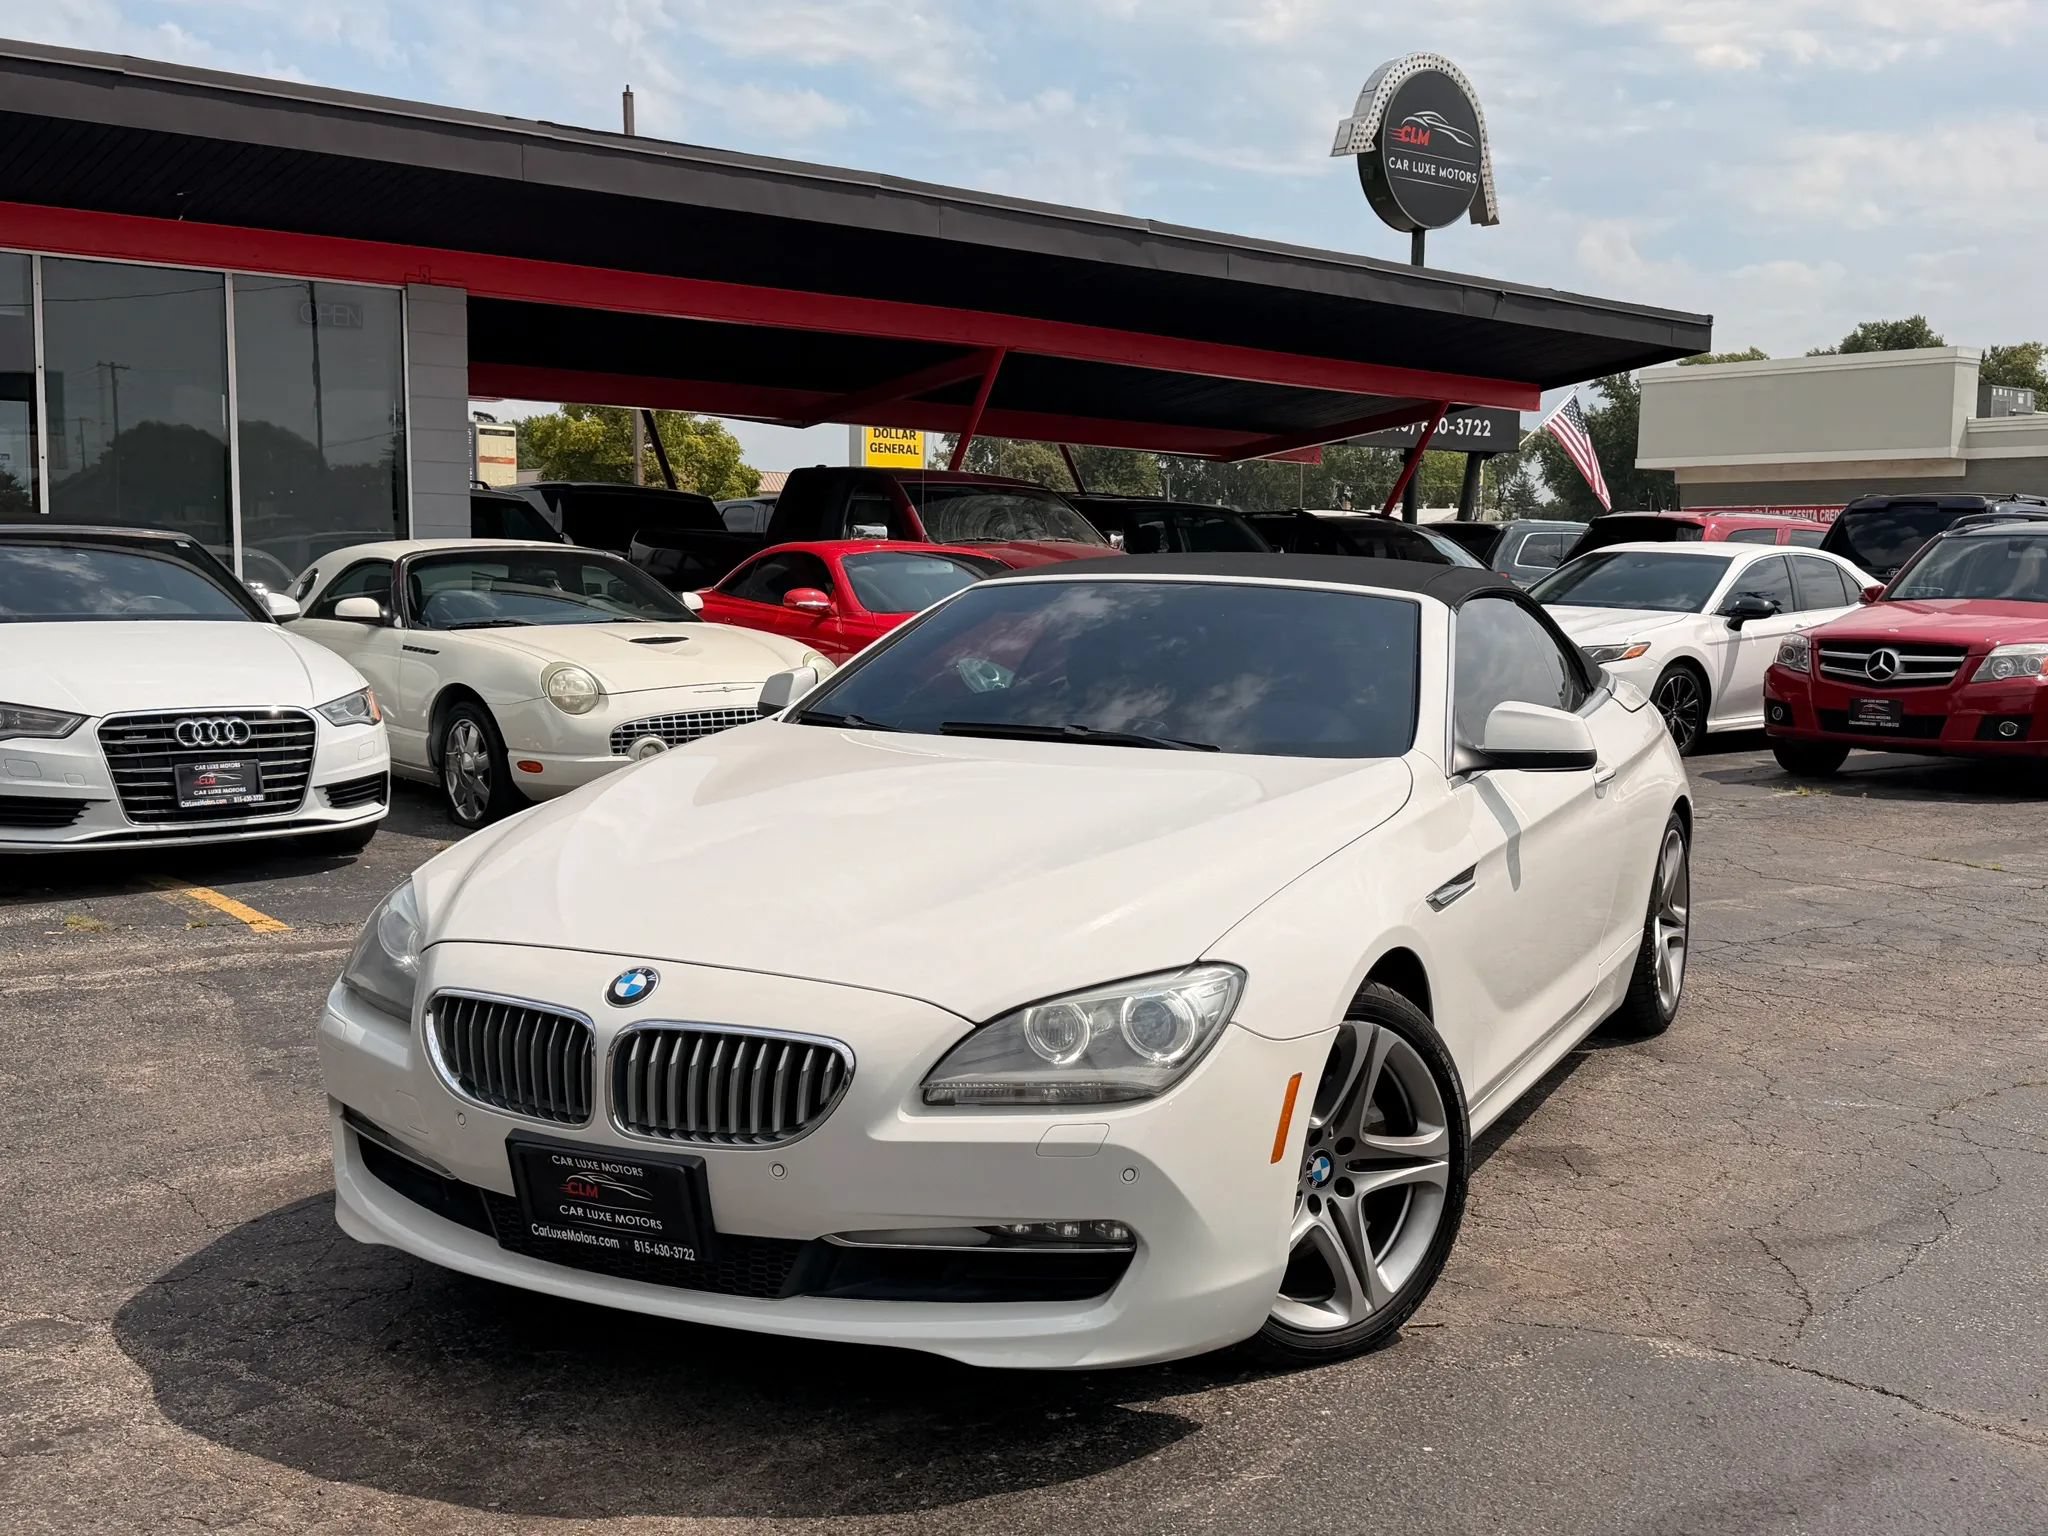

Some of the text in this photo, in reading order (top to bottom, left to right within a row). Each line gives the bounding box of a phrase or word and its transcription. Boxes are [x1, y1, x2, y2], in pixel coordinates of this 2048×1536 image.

[1400, 126, 1431, 147] CLM
[1388, 157, 1477, 184] CAR LUXE MOTORS
[874, 428, 916, 440] DOLLAR
[870, 443, 919, 455] GENERAL
[551, 1155, 644, 1177] CAR LUXE MOTORS
[566, 1181, 599, 1199] CLM
[559, 1204, 663, 1230] CAR LUXE MOTORS
[531, 1223, 696, 1261] CarLuxeMotors.com 815-630-3722
